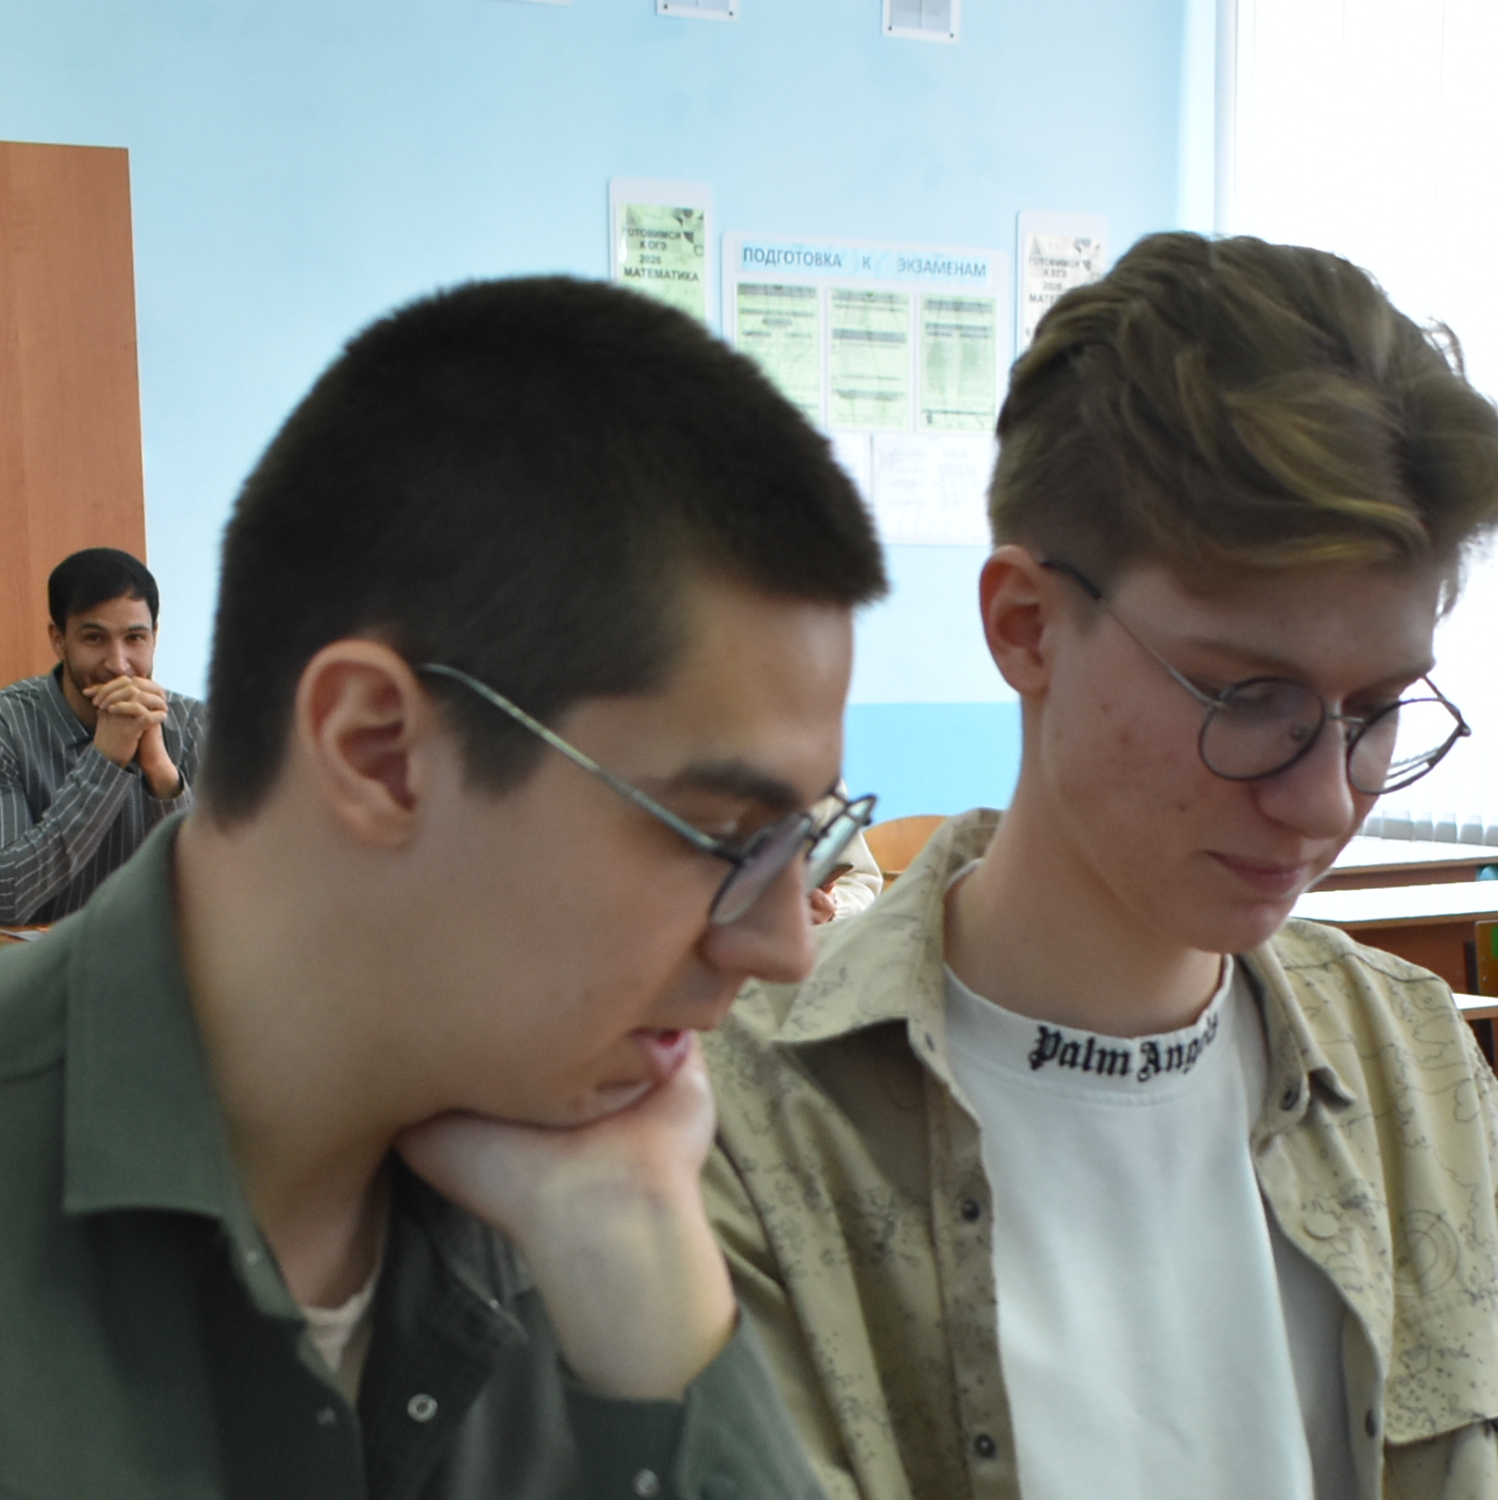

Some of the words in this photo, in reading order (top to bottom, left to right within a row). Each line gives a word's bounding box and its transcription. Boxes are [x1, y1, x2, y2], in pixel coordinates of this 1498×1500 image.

[647, 240, 667, 250] ОГЭ
[743, 247, 842, 268] ПОДГОТОВКА
[862, 256, 871, 270] К
[897, 258, 986, 277] ЭКЗАМЕНАМ
[623, 266, 699, 281] МАТЕМАТИКА
[1028, 1025, 1131, 1076] Palm
